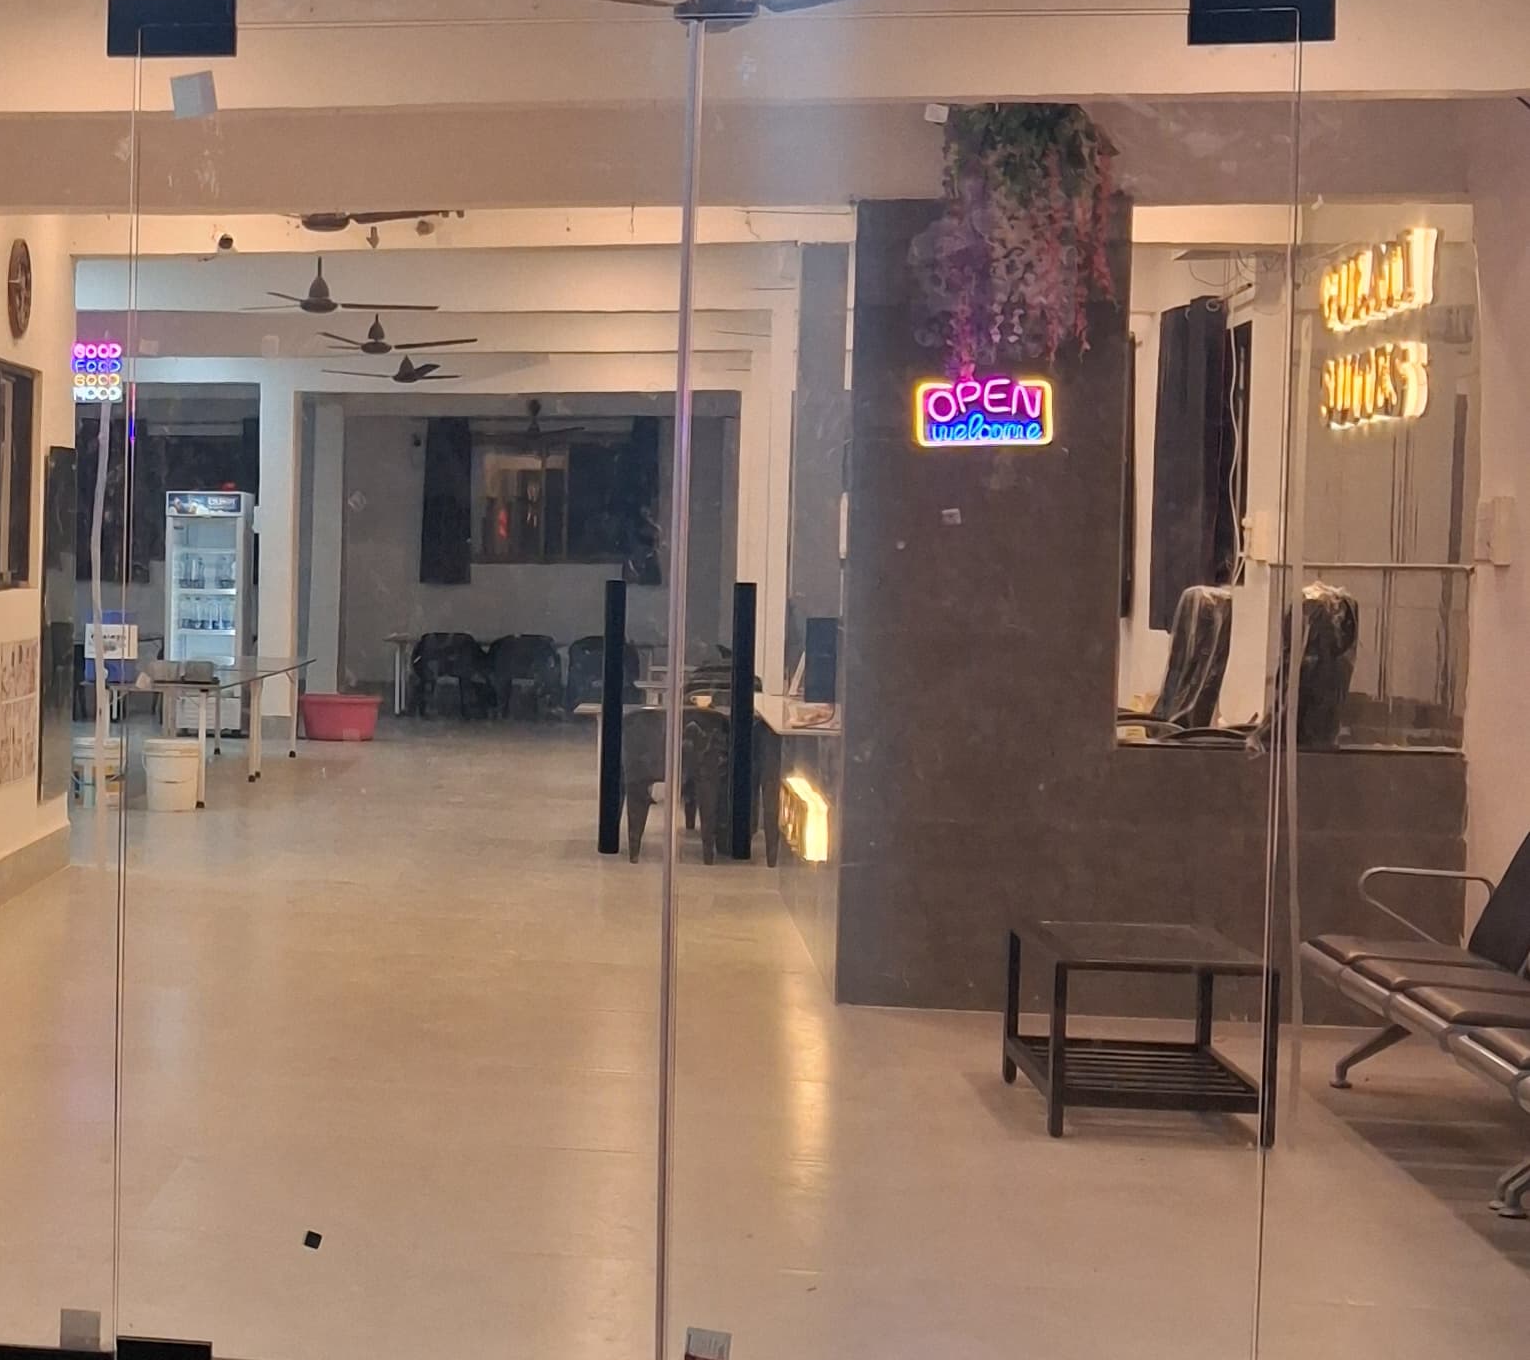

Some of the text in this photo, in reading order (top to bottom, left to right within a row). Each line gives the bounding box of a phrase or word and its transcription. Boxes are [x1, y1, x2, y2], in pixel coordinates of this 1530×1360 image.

[74, 344, 121, 358] GOOD
[75, 360, 121, 373] FOOD
[74, 373, 120, 386] GOOD
[73, 386, 122, 400] MOOD
[927, 379, 1042, 422] OPEN
[932, 414, 1042, 441] welcome
